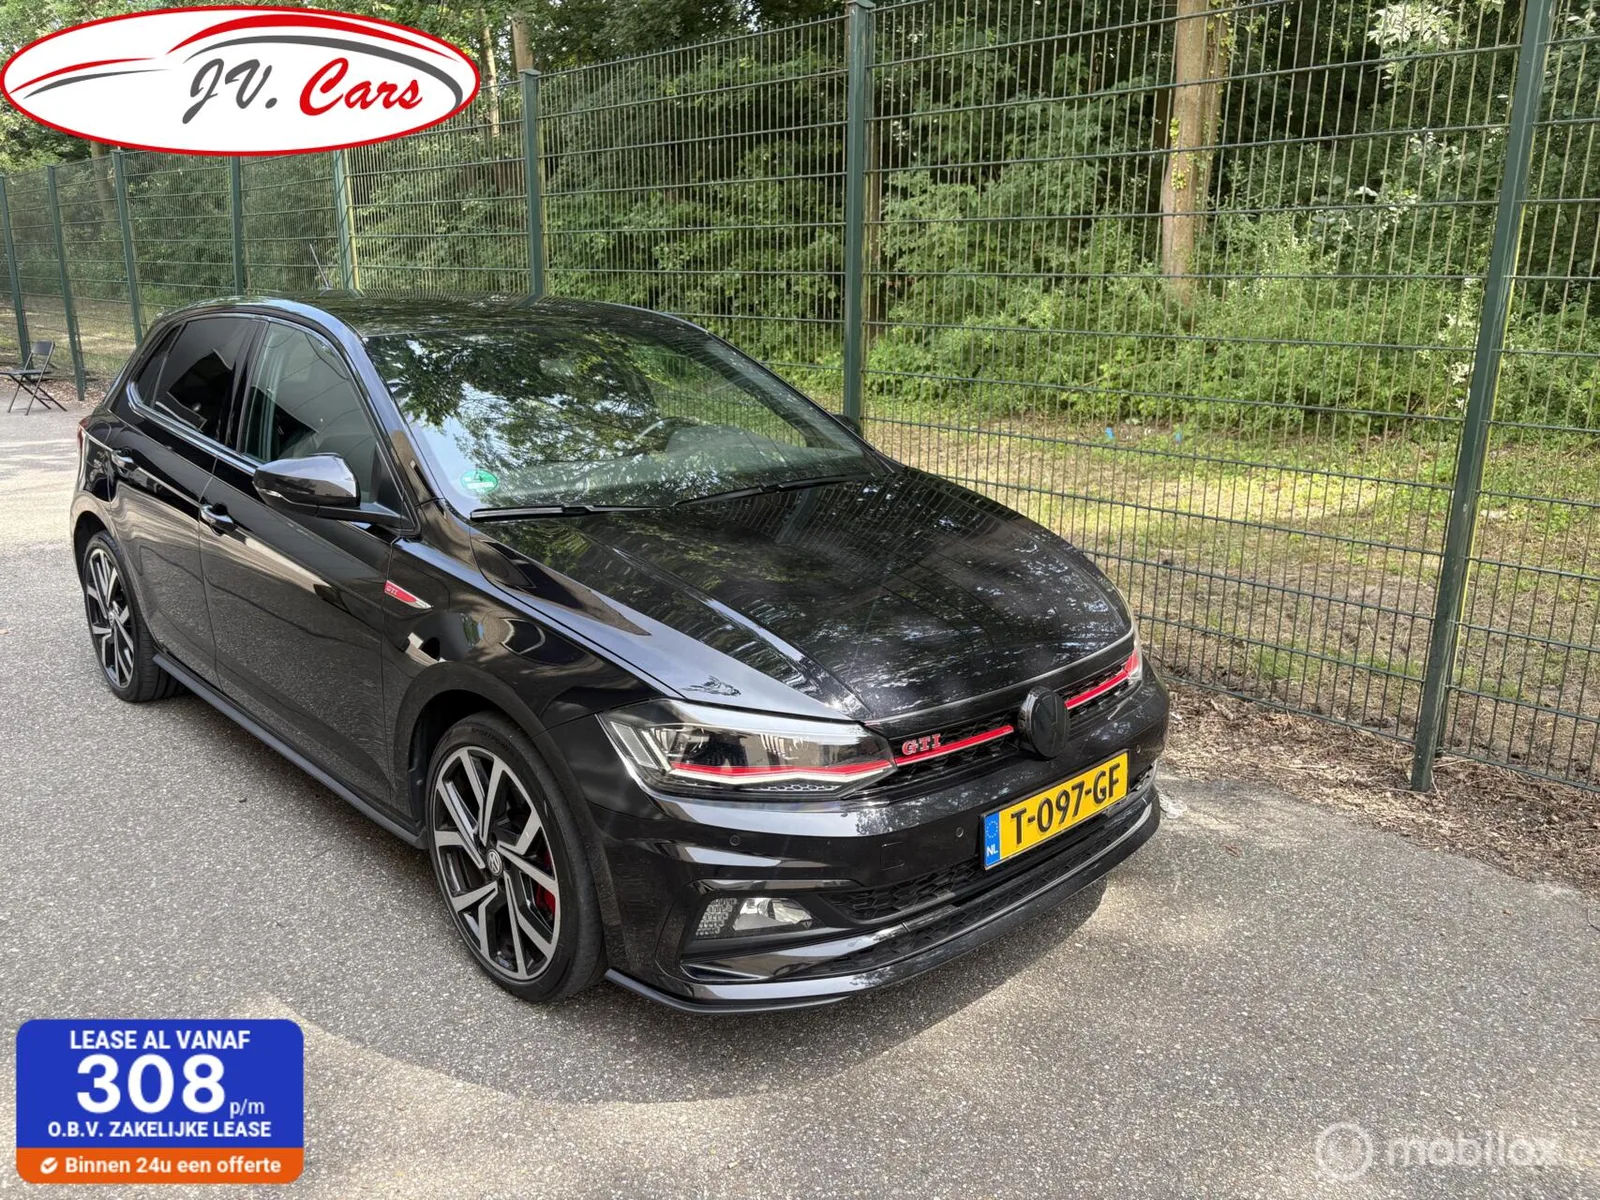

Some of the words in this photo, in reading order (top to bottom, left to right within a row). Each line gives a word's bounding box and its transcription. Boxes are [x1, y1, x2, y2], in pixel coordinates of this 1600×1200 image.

[902, 733, 942, 756] GTI
[1011, 762, 1121, 845] T-097-GF
[986, 843, 998, 857] NL
